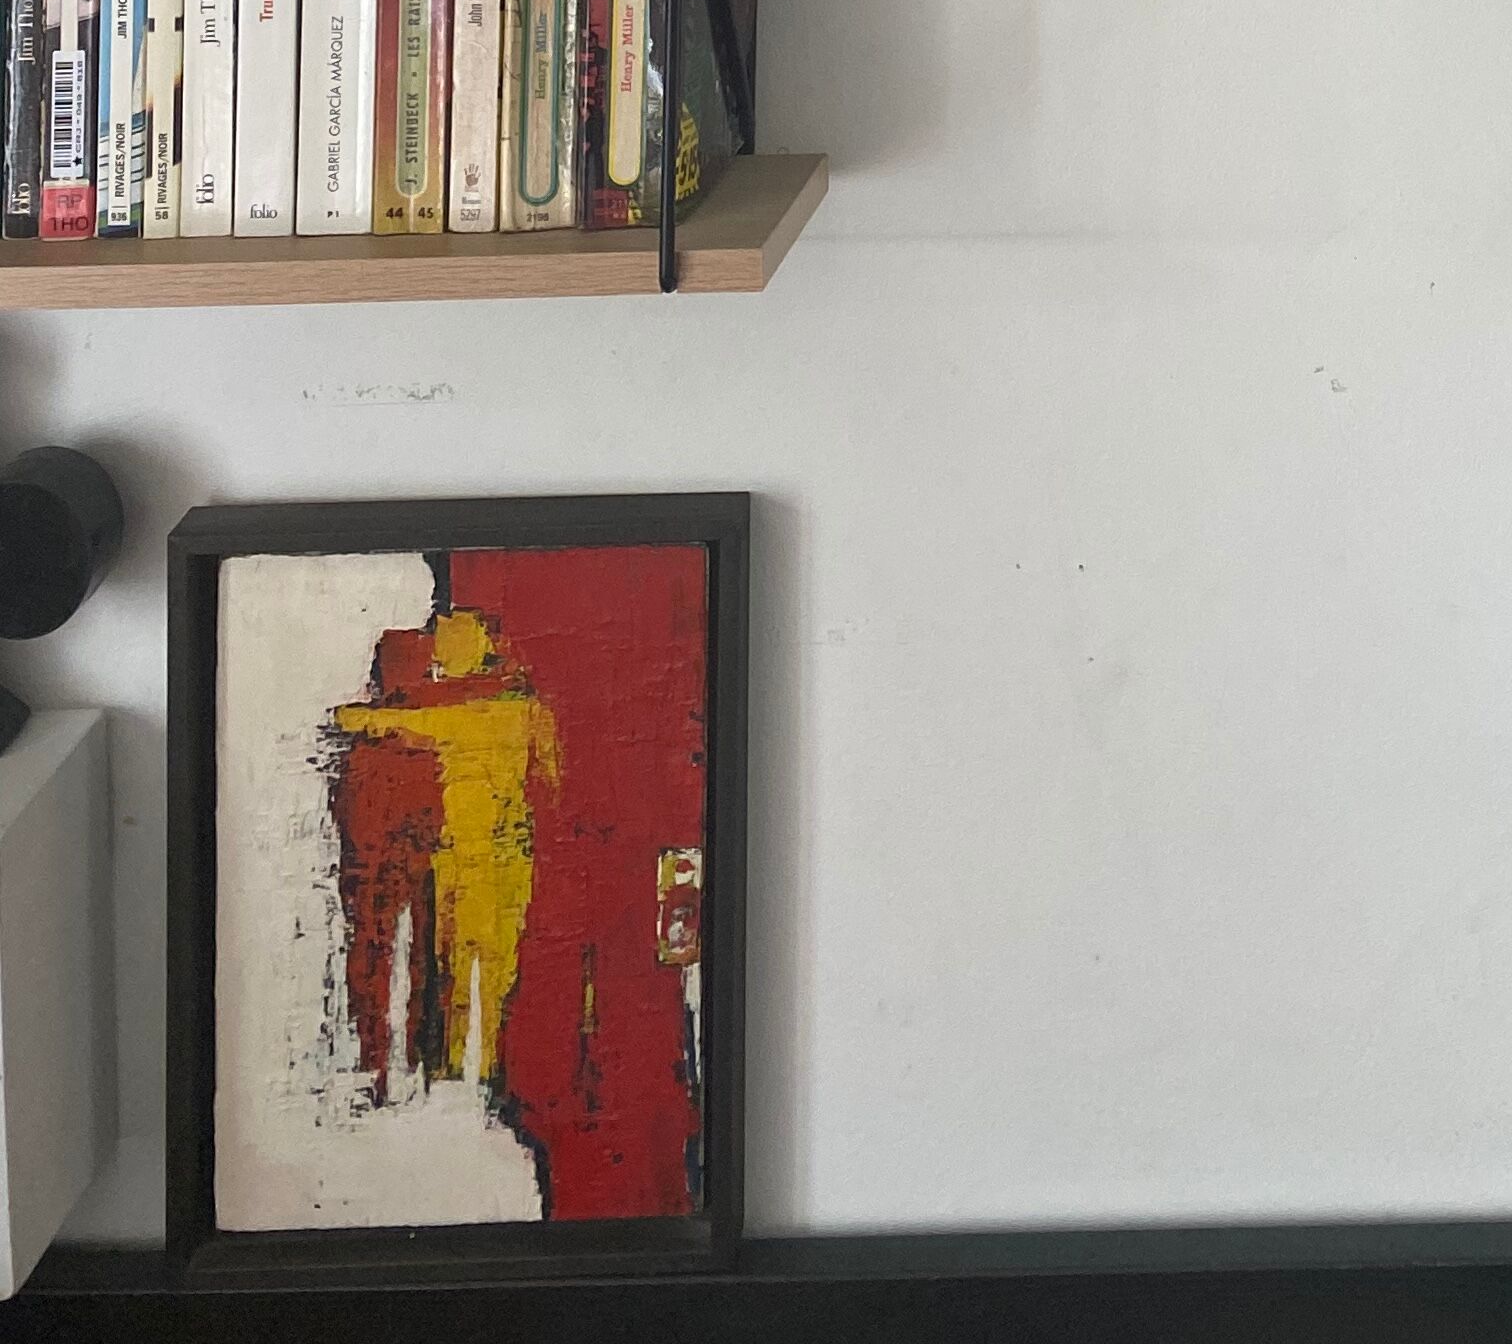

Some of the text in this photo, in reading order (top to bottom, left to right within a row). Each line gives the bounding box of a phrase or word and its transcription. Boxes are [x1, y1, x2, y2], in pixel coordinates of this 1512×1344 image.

[468, 3, 483, 28] John
[326, 16, 345, 82] MÁRQUEZ
[326, 86, 343, 138] GARCÍA
[327, 141, 342, 193] GABRIEL
